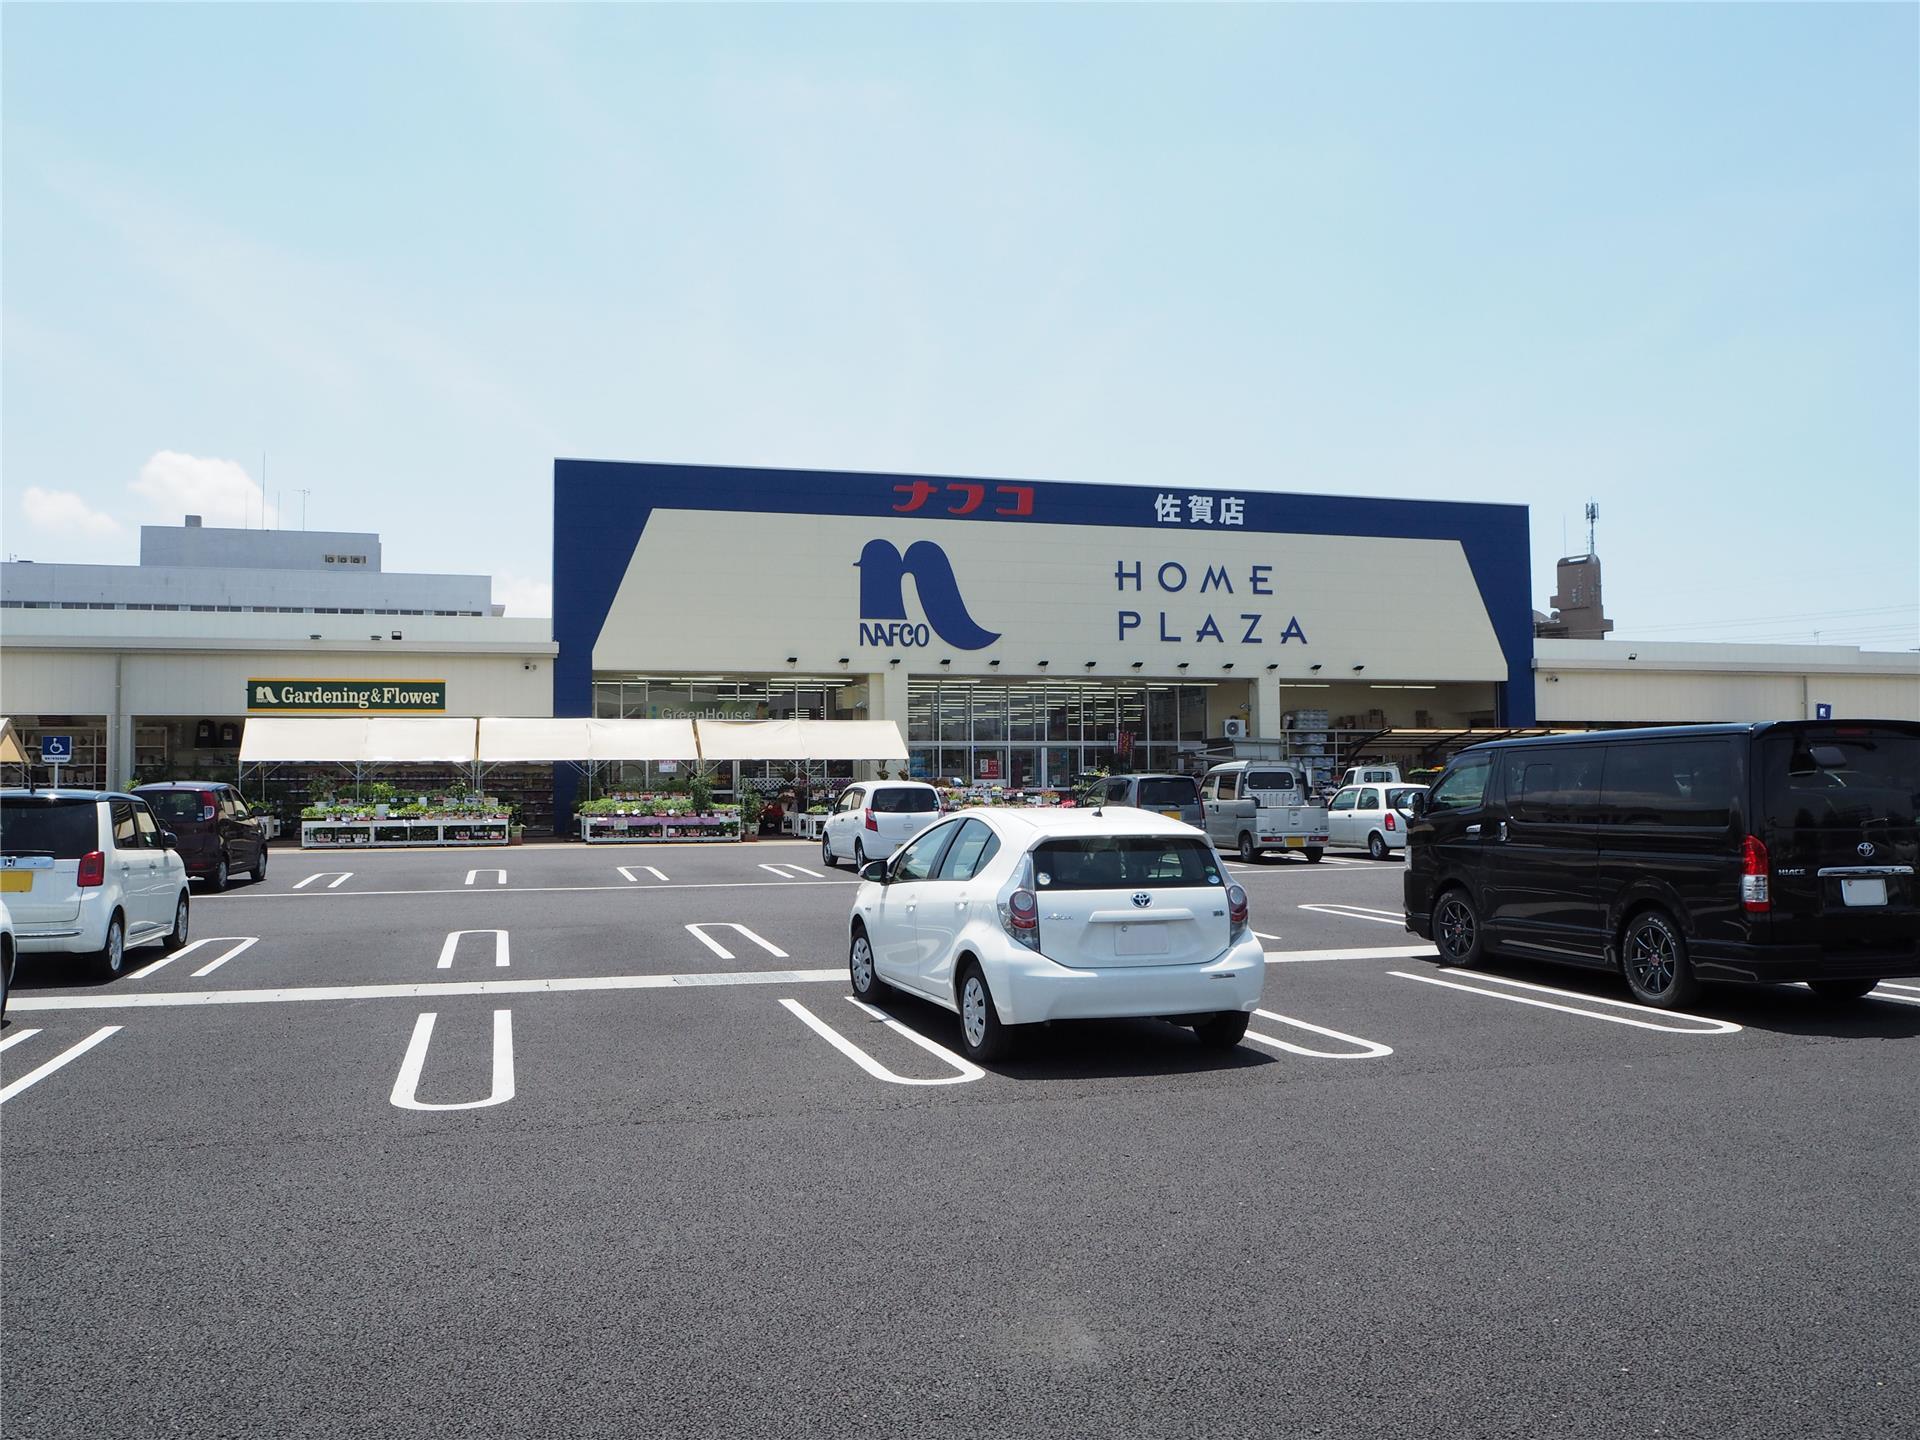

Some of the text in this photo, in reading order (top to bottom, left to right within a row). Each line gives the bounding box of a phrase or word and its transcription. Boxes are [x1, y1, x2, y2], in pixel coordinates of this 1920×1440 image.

[892, 481, 1034, 515] ナフコ
[1154, 494, 1245, 525] 佐賀店
[1114, 560, 1273, 595] HOME
[859, 622, 930, 647] NAFCO
[1118, 611, 1307, 645] PLAZA
[281, 686, 440, 709] Gardening&Flower
[661, 707, 751, 720] GreenHouse
